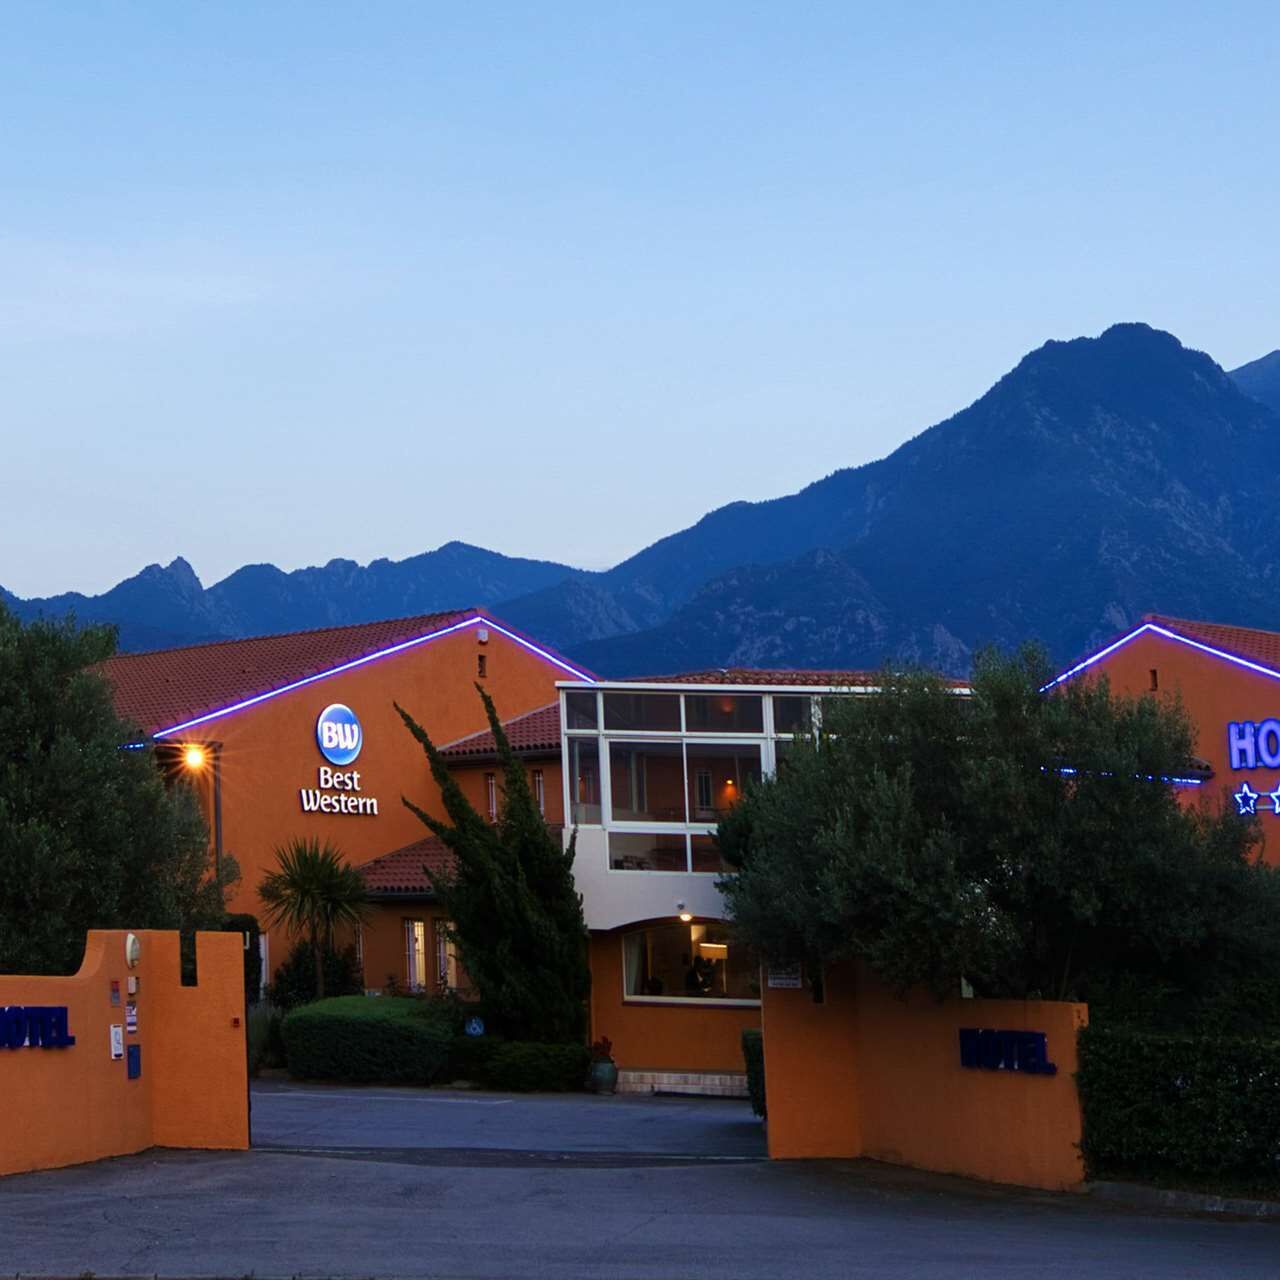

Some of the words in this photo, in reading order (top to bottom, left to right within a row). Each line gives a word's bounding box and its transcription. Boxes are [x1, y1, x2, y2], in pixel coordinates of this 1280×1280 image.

[322, 721, 359, 750] BW
[319, 766, 361, 791] Best
[301, 788, 378, 815] Western
